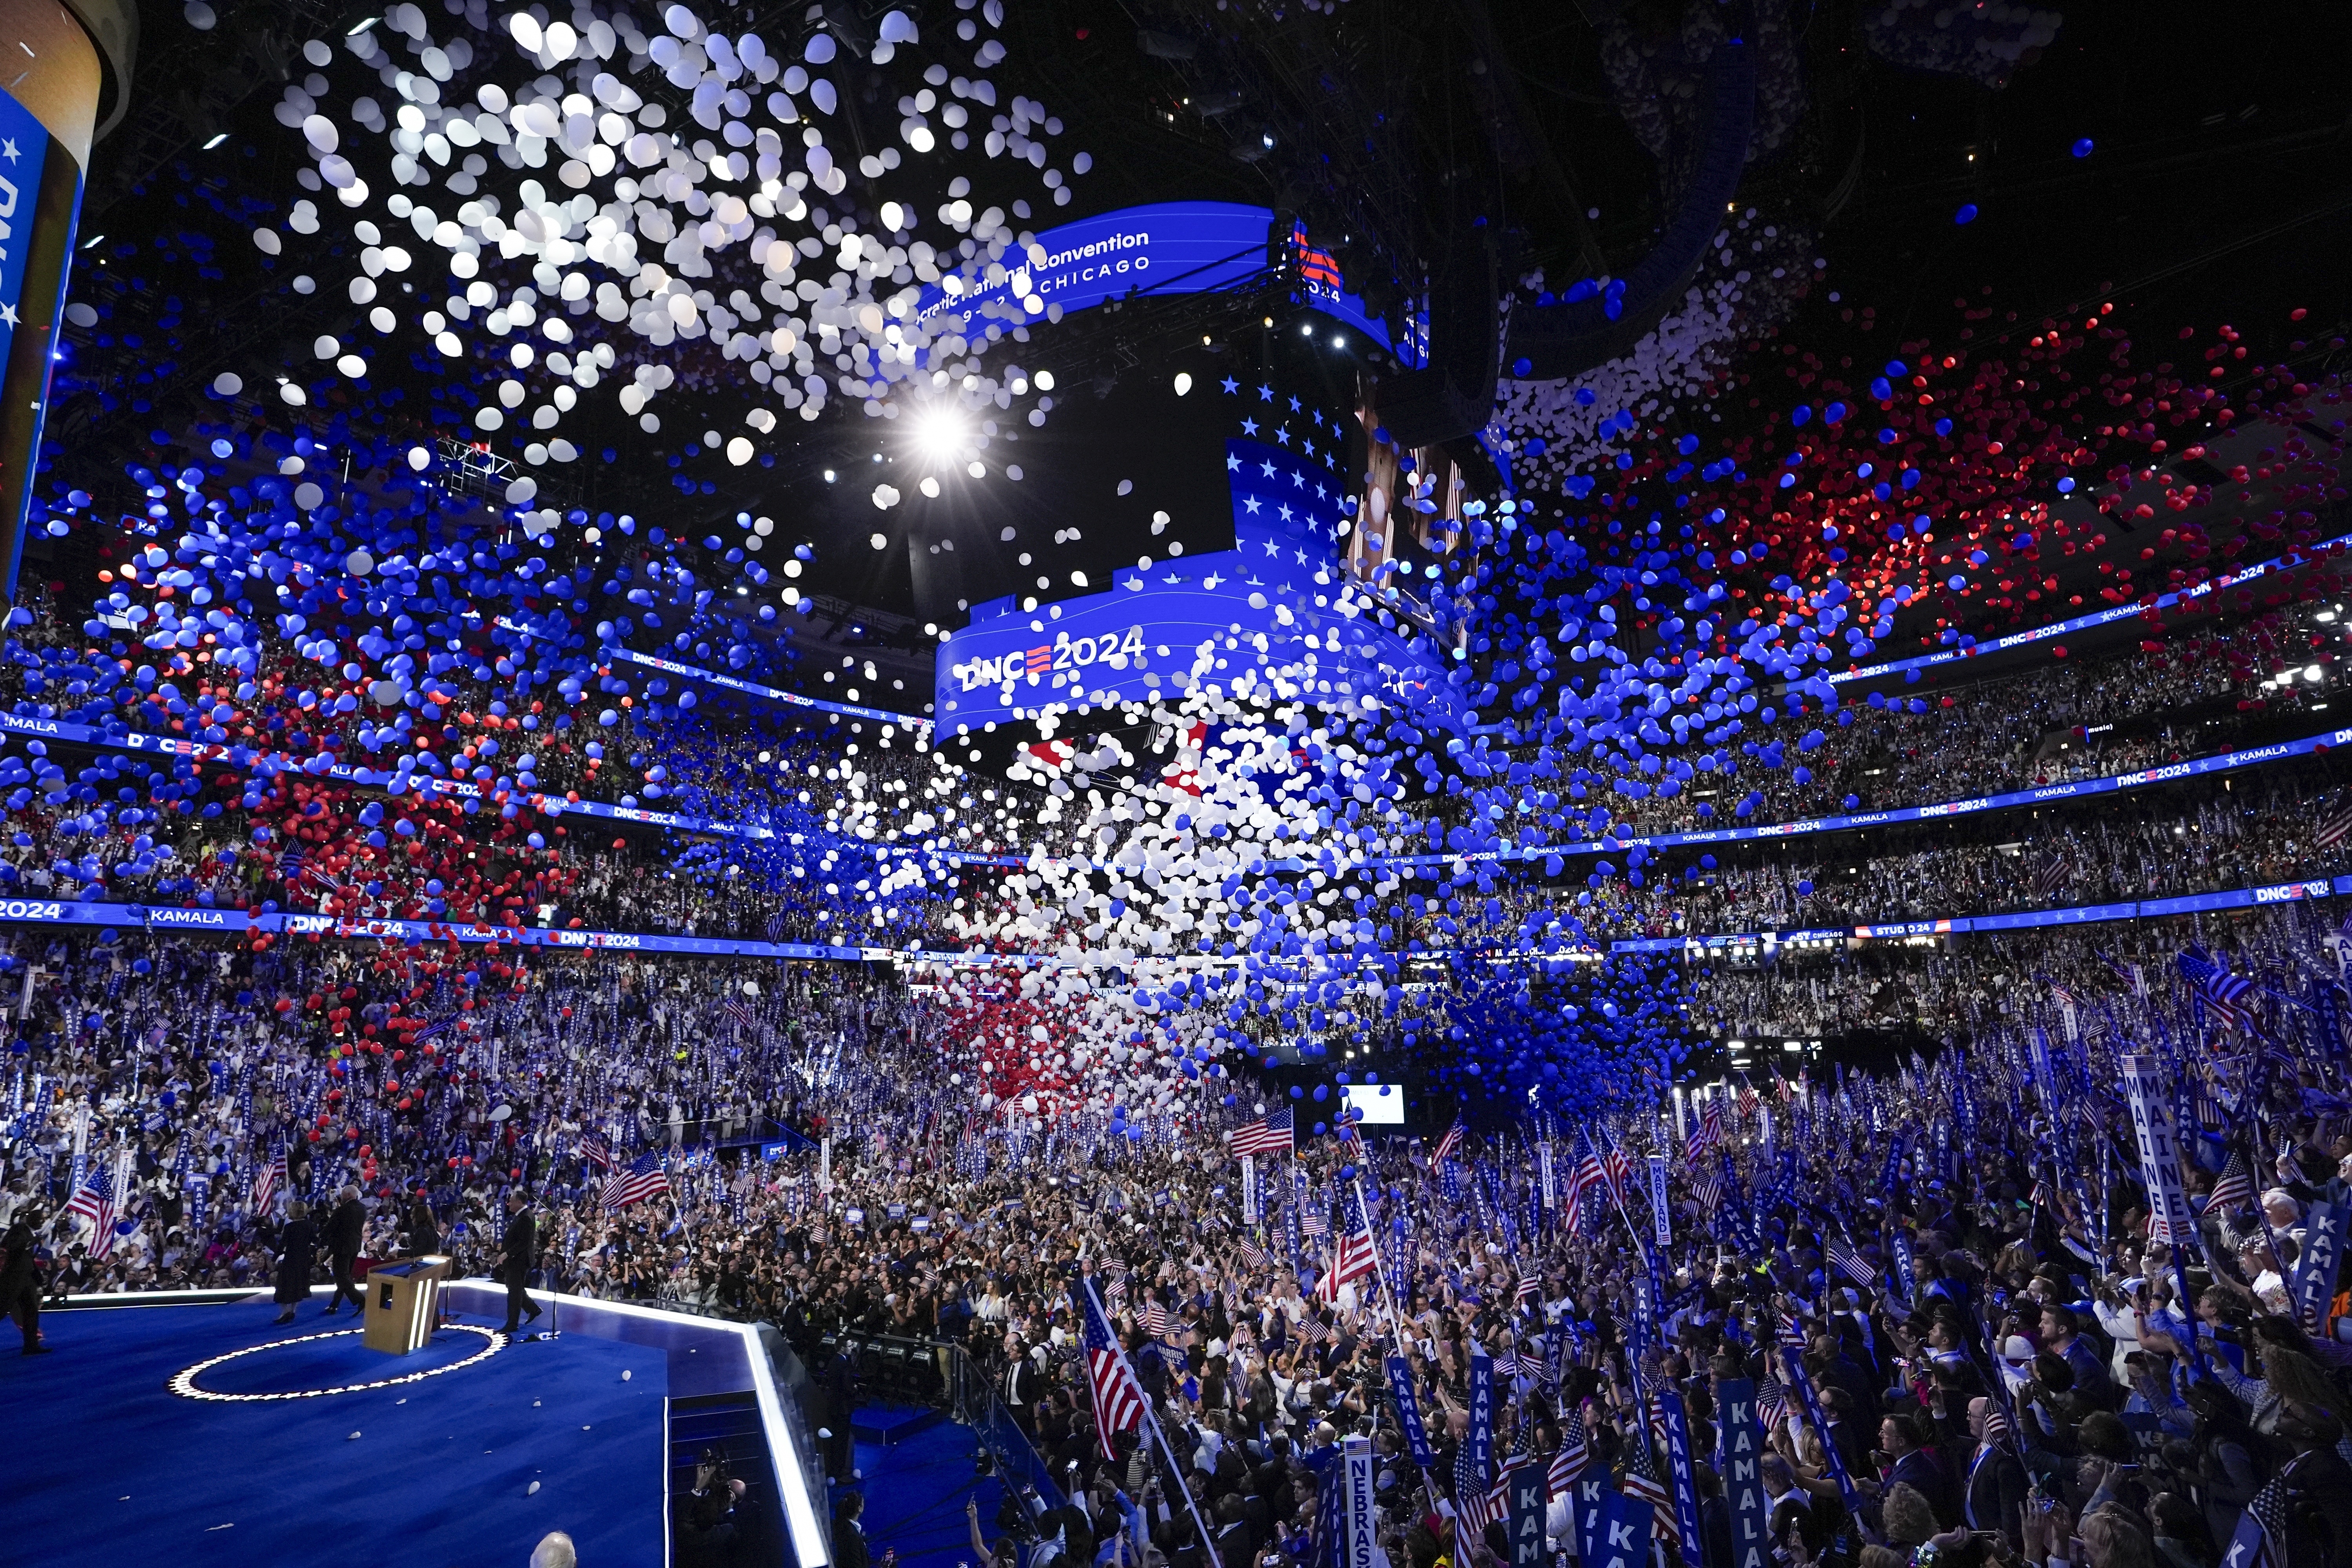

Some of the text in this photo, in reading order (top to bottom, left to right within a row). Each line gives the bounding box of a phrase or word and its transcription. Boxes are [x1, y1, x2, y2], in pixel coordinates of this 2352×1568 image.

[1041, 257, 1149, 293] CHICAGO
[2035, 623, 2066, 638] 2024
[662, 661, 686, 674] 2024
[717, 675, 743, 688] KAMALA
[1862, 664, 1889, 677] 2024
[842, 706, 869, 716] KAMALA
[2239, 746, 2288, 761] KAMALA
[2117, 764, 2191, 787] DNC 2024
[1920, 799, 1988, 817] DNC 2024
[2035, 786, 2076, 798] KAMALA
[614, 806, 676, 825] DNC 2024
[1758, 821, 1821, 837] DNC 2024
[1851, 813, 1888, 824] KAMALA
[1682, 833, 1717, 841] KAMALA
[2256, 886, 2291, 902] DNC
[151, 910, 224, 924] KAMALA
[1917, 924, 1930, 932] 24
[606, 935, 640, 947] 2024
[2291, 946, 2333, 980] KAMALA
[2319, 988, 2342, 1052] KAMALA
[176, 1136, 189, 1169] KAMALA
[1007, 1139, 1017, 1164] KAMALA
[2126, 1076, 2163, 1216] MAINE
[2141, 1076, 2184, 1216] MAINE
[241, 1162, 251, 1195] KAMALA
[1887, 1143, 1901, 1189] KAMALA
[118, 1158, 128, 1207] TENNESSEE
[1334, 1175, 1344, 1207] KAMALA
[1475, 1187, 1487, 1226] KAMALA
[1653, 1167, 1667, 1233] MARYLAND
[1287, 1210, 1296, 1255] KAMALA
[2077, 1188, 2102, 1267] KAMALA
[1894, 1236, 1915, 1290] KAMALA
[1649, 1247, 1662, 1314] KAMALA
[1157, 1344, 1184, 1360] HARRIS
[1393, 1369, 1425, 1455] KAMALA
[1477, 1371, 1488, 1480] KAMALA
[1793, 1362, 1850, 1495] KAMALA
[1667, 1411, 1699, 1553] KAMALA
[1731, 1401, 1762, 1568] KAMALA
